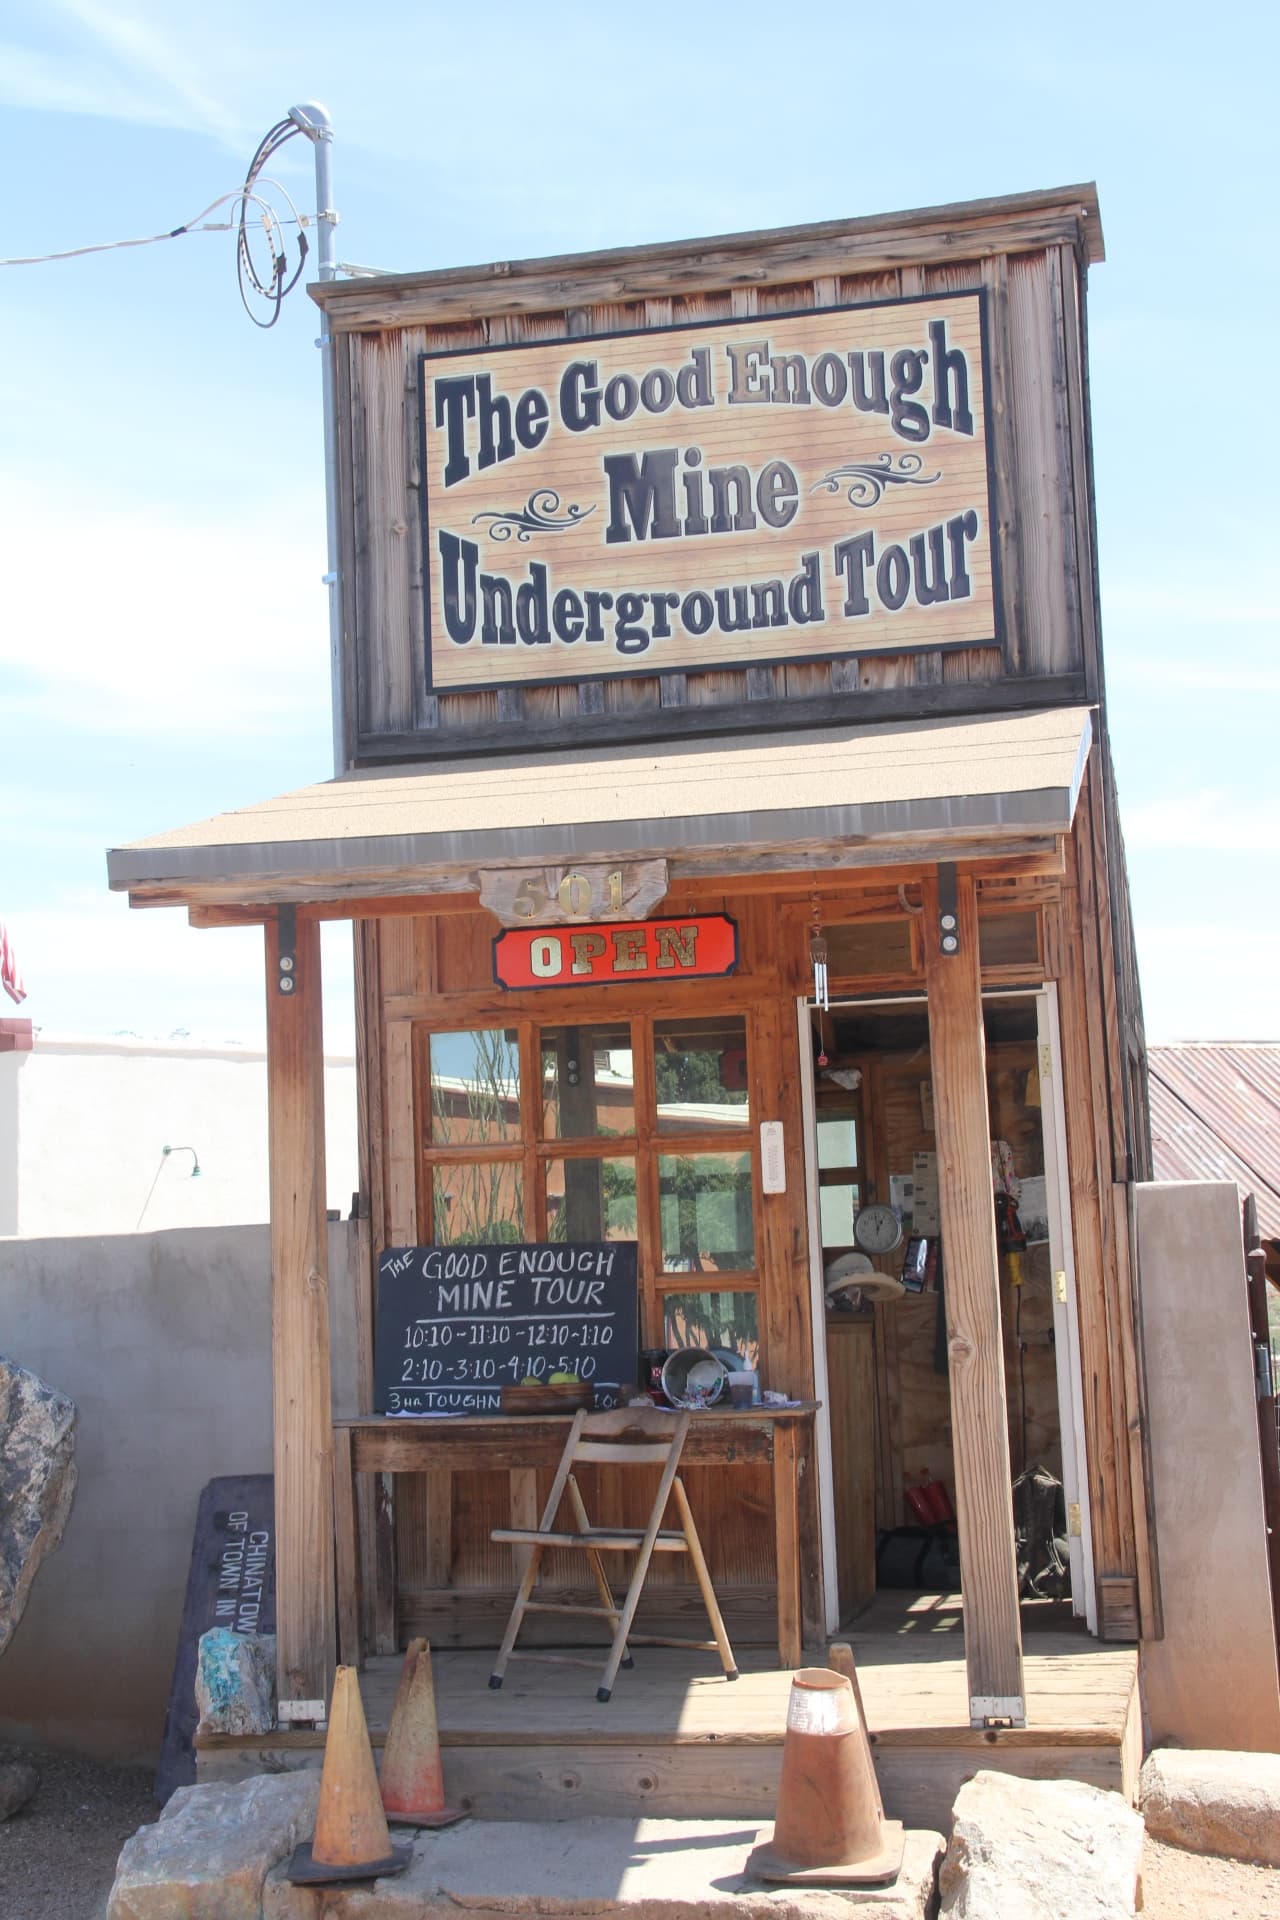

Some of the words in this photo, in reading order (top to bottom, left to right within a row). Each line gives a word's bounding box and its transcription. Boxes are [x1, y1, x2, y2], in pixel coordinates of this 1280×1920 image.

[434, 372, 549, 488] The
[558, 344, 715, 434] Good
[725, 318, 975, 443] Enough
[602, 445, 800, 545] Mine
[438, 528, 827, 656] Underground
[832, 508, 980, 618] Tour
[512, 871, 624, 919] 501
[529, 926, 699, 979] OPEN
[380, 1249, 415, 1279] THE
[422, 1251, 487, 1280] GOOD
[499, 1249, 616, 1277] ENOUGH
[436, 1279, 515, 1312] MINE
[531, 1277, 606, 1306] TOUR
[425, 1391, 501, 1409] TOUGHN
[227, 1511, 249, 1532] OF
[219, 1537, 246, 1590] TOWN
[237, 1531, 269, 1634] CHINATOW
[215, 1599, 237, 1617] IN
